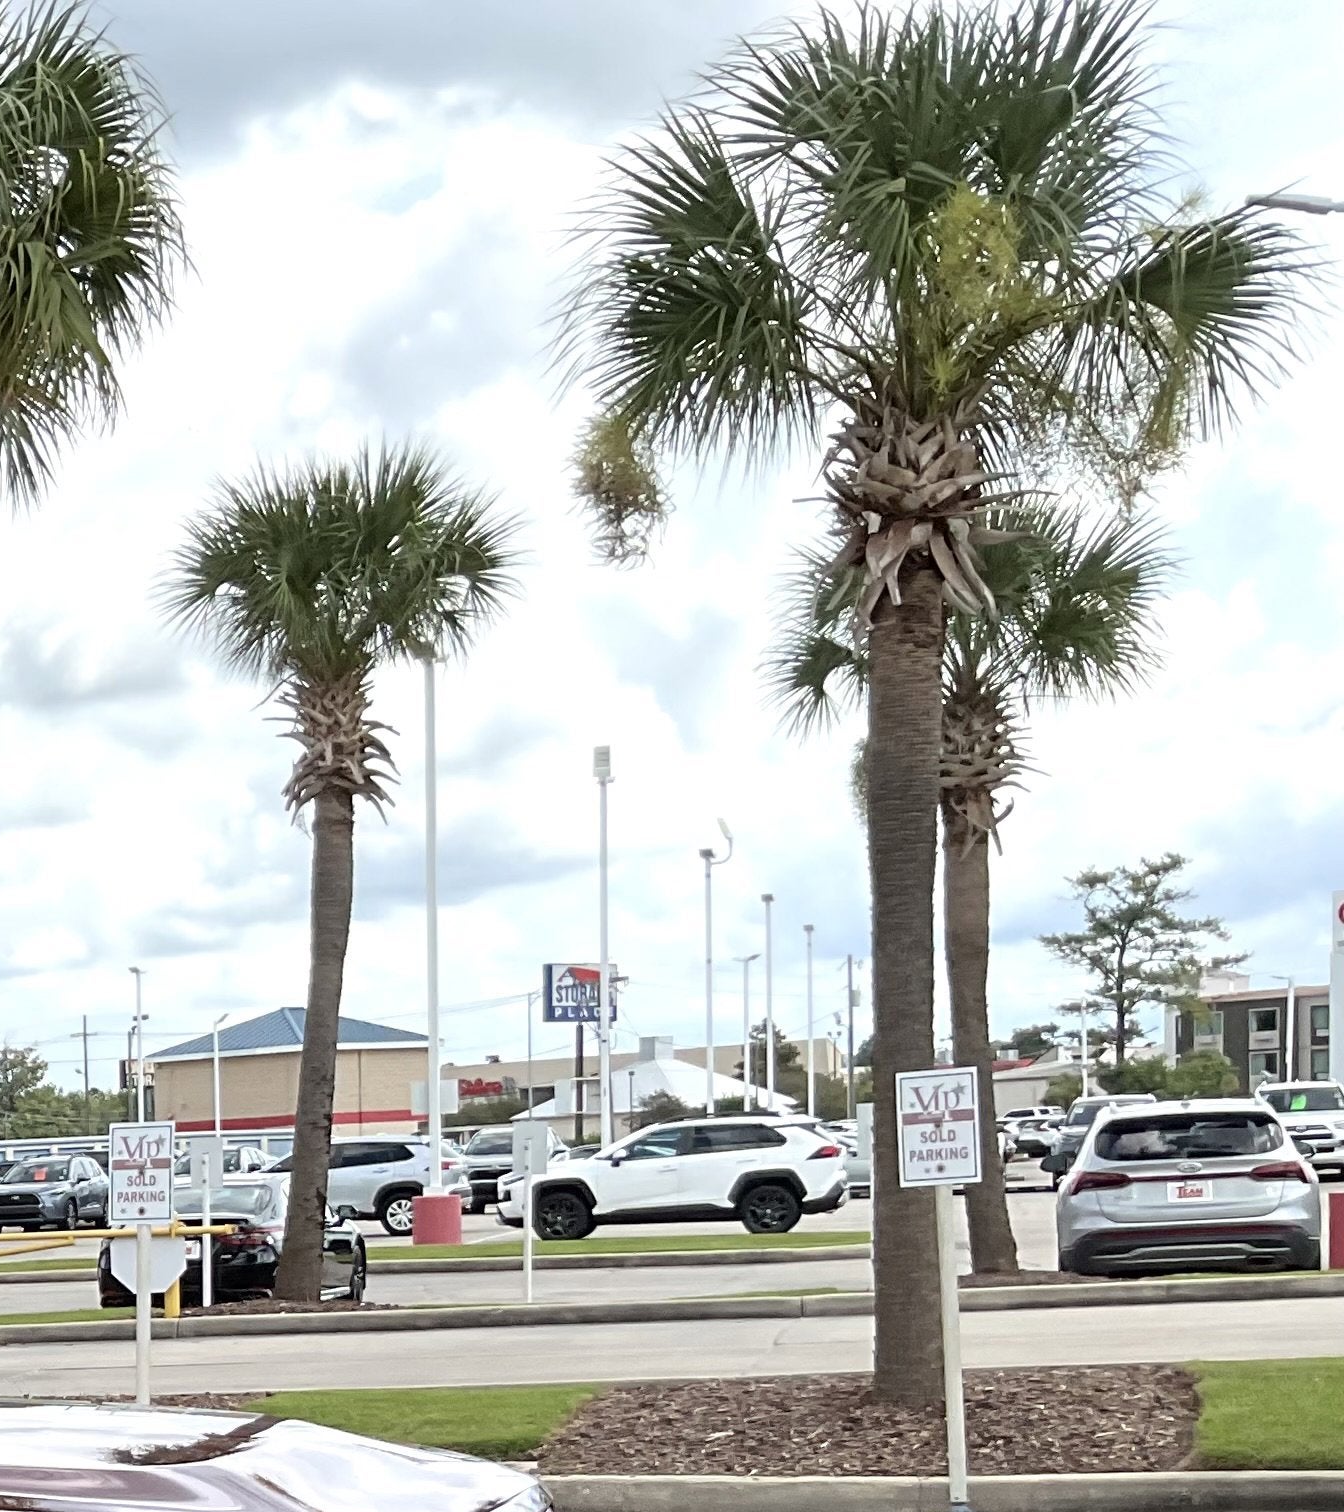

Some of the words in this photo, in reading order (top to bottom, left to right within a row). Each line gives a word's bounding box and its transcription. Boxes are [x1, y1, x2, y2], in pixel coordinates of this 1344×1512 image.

[555, 984, 614, 1004] STORA
[920, 1129, 956, 1144] SOLD
[909, 1147, 969, 1163] PARKING
[126, 1175, 157, 1187] SOLD
[117, 1191, 165, 1203] PARKING
